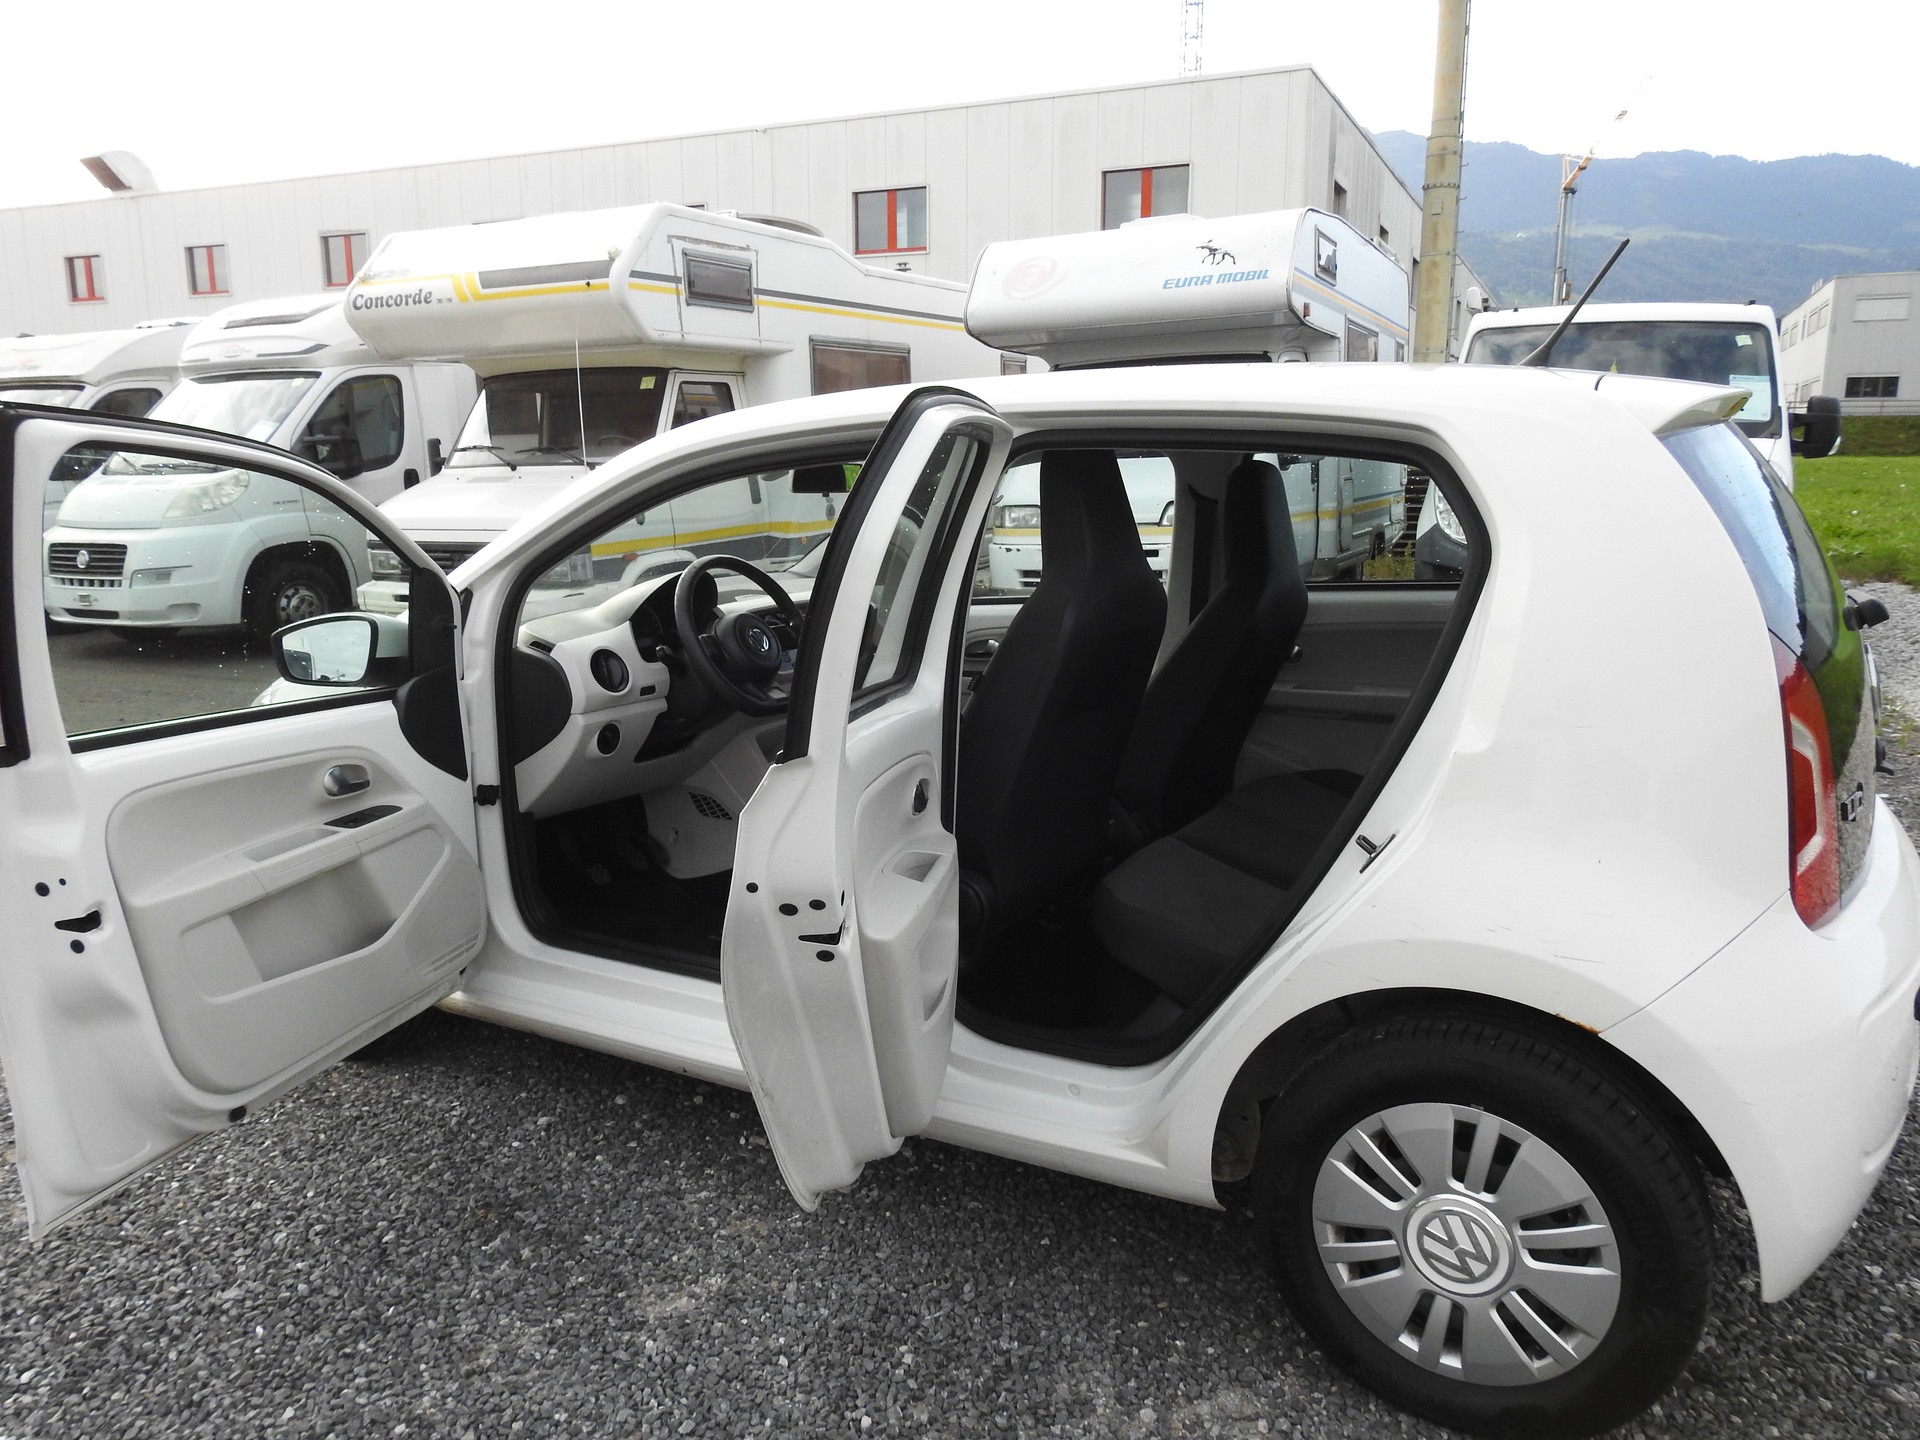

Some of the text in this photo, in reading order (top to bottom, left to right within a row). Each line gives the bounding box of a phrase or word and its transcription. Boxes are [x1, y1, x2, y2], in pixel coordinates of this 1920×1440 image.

[1162, 269, 1270, 290] EURA MOBIL
[352, 288, 433, 311] Concorde
[1417, 1210, 1500, 1284] VW
